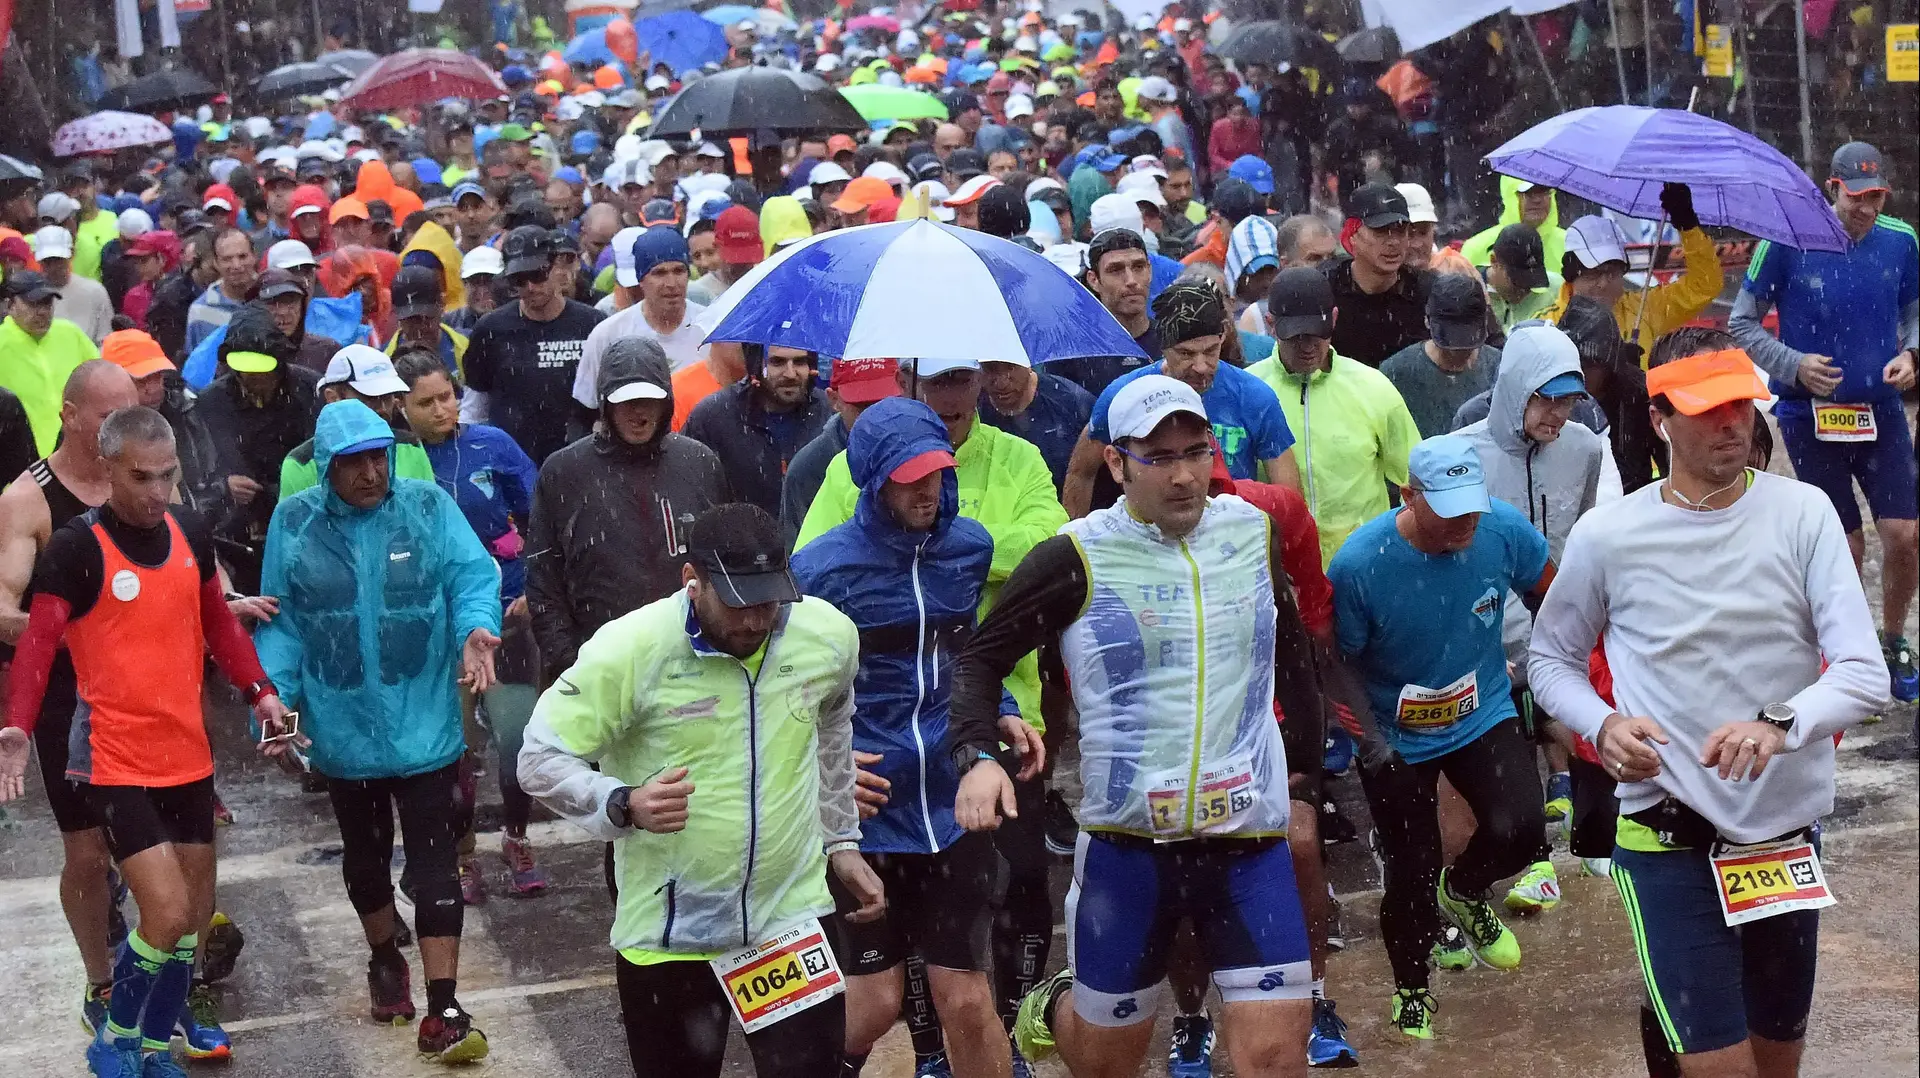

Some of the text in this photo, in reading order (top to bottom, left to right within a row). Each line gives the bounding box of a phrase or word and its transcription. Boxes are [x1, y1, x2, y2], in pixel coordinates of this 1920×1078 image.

[537, 350, 581, 361] TRACK
[1143, 389, 1172, 406] TEAM
[1820, 413, 1855, 426] 1900
[1404, 704, 1453, 721] 2361
[1214, 766, 1235, 779] מרתון
[1158, 797, 1226, 824] 165
[1725, 868, 1789, 896] 2181
[779, 929, 800, 945] מרתון
[732, 948, 758, 965] טבריה
[736, 960, 802, 1004] 1064
[907, 955, 929, 1026] kalenji
